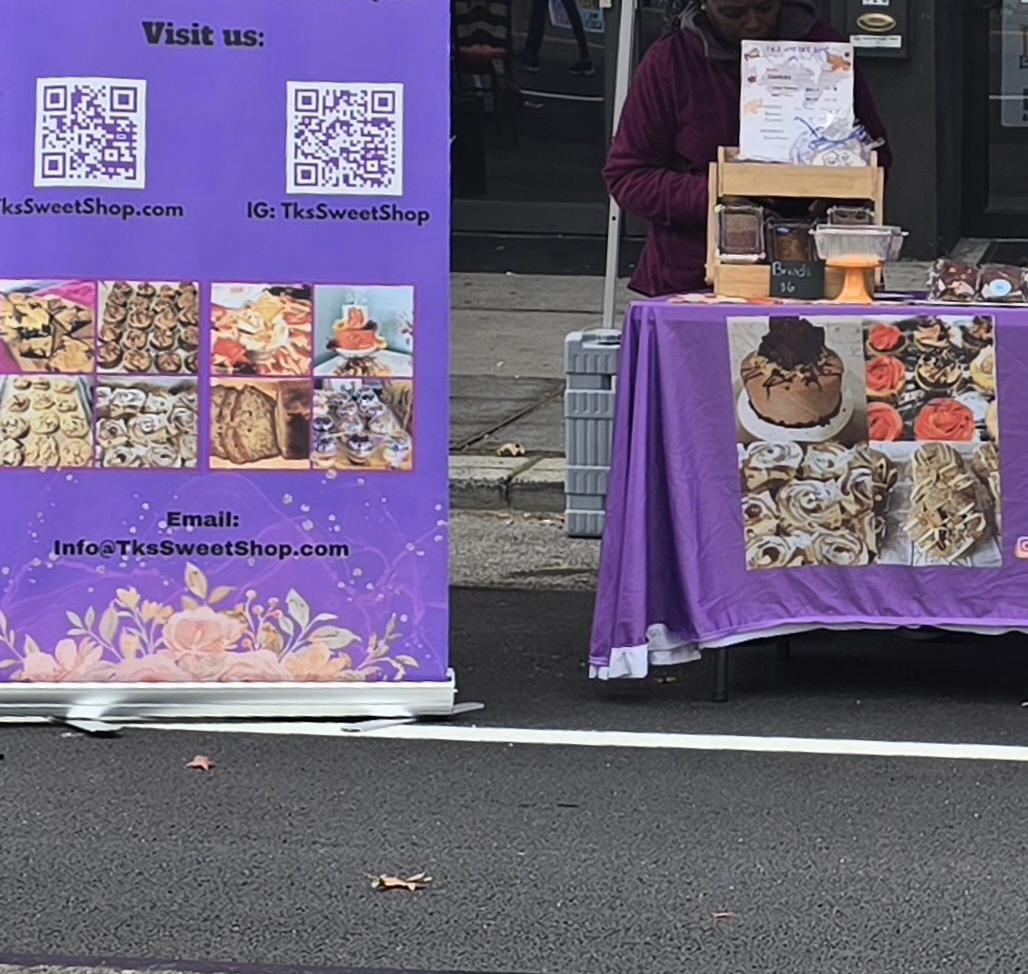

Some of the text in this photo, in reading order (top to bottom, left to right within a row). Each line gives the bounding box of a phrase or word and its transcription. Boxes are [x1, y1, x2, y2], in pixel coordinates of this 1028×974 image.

[142, 20, 265, 47] Visit us:
[0, 197, 184, 220] ksSweetShop.com
[247, 201, 431, 226] IG: TksSweetShop
[166, 511, 239, 529] Email:
[53, 539, 350, 559] Info@TksSweetShop.com
